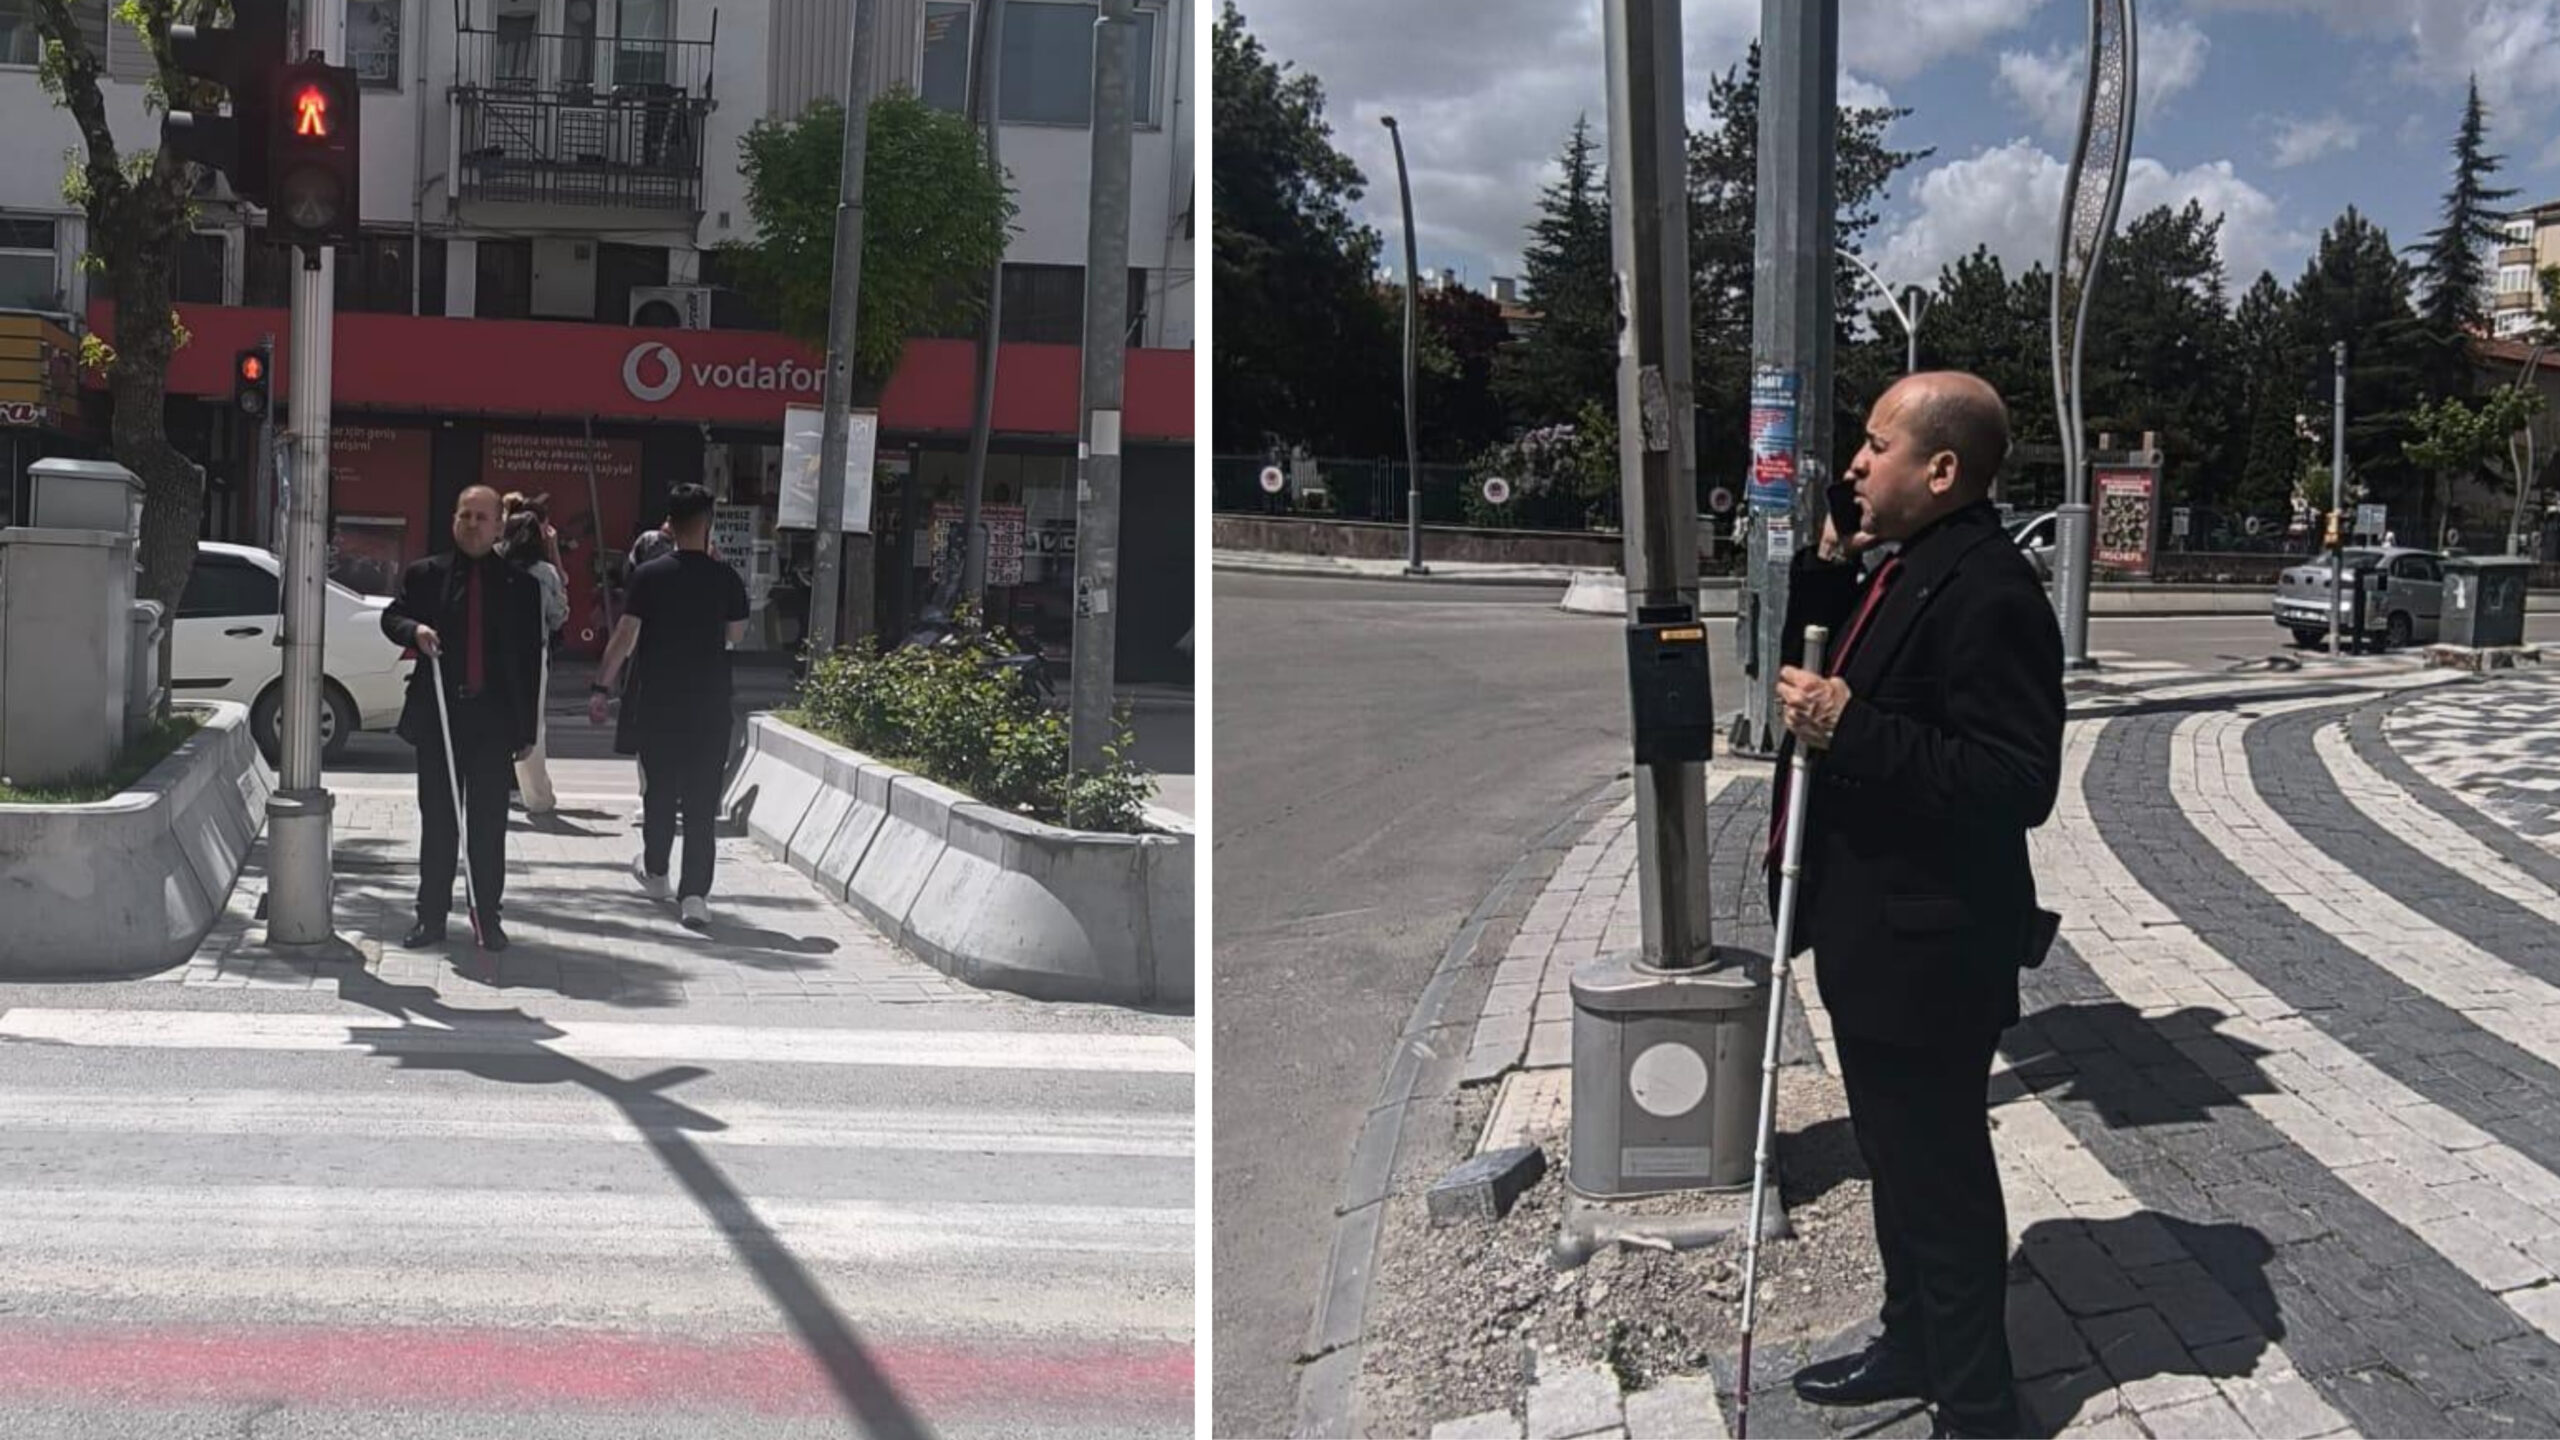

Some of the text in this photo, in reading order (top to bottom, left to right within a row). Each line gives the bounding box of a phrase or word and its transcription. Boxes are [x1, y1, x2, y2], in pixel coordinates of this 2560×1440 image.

[691, 358, 828, 392] vodafon
[492, 458, 504, 469] 12
[716, 511, 750, 519] NIRSIZ
